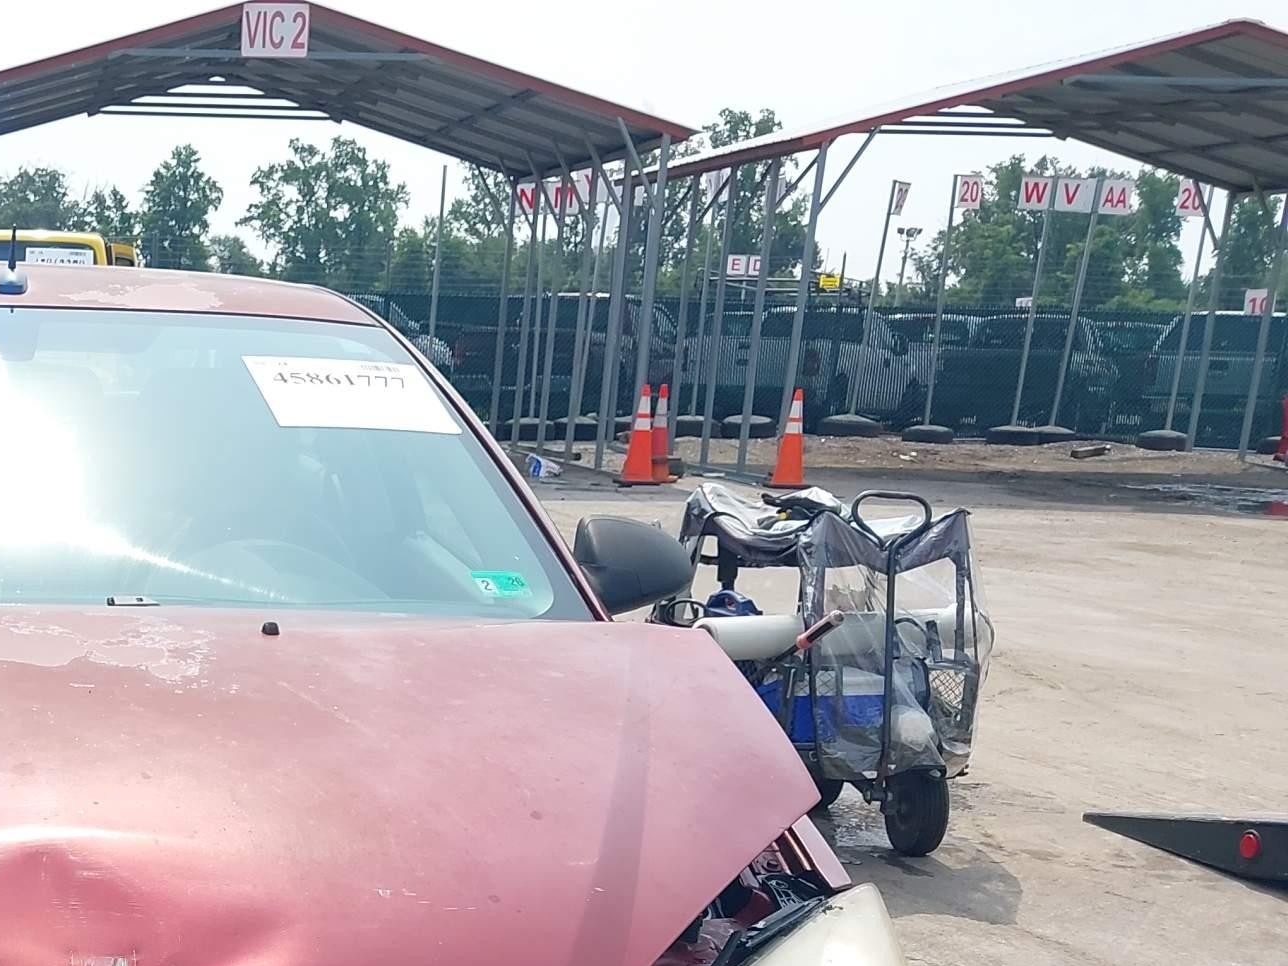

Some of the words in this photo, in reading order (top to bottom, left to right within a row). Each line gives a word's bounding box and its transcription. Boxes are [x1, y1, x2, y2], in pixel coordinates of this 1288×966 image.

[245, 10, 285, 49] VIC
[291, 11, 306, 49] 2
[519, 188, 536, 209] N
[960, 181, 979, 202] 20
[1024, 181, 1048, 204] W
[1064, 182, 1080, 205] V
[1102, 187, 1126, 209] AA
[731, 258, 741, 271] E
[273, 371, 404, 389] 45861777
[480, 579, 493, 591] 2
